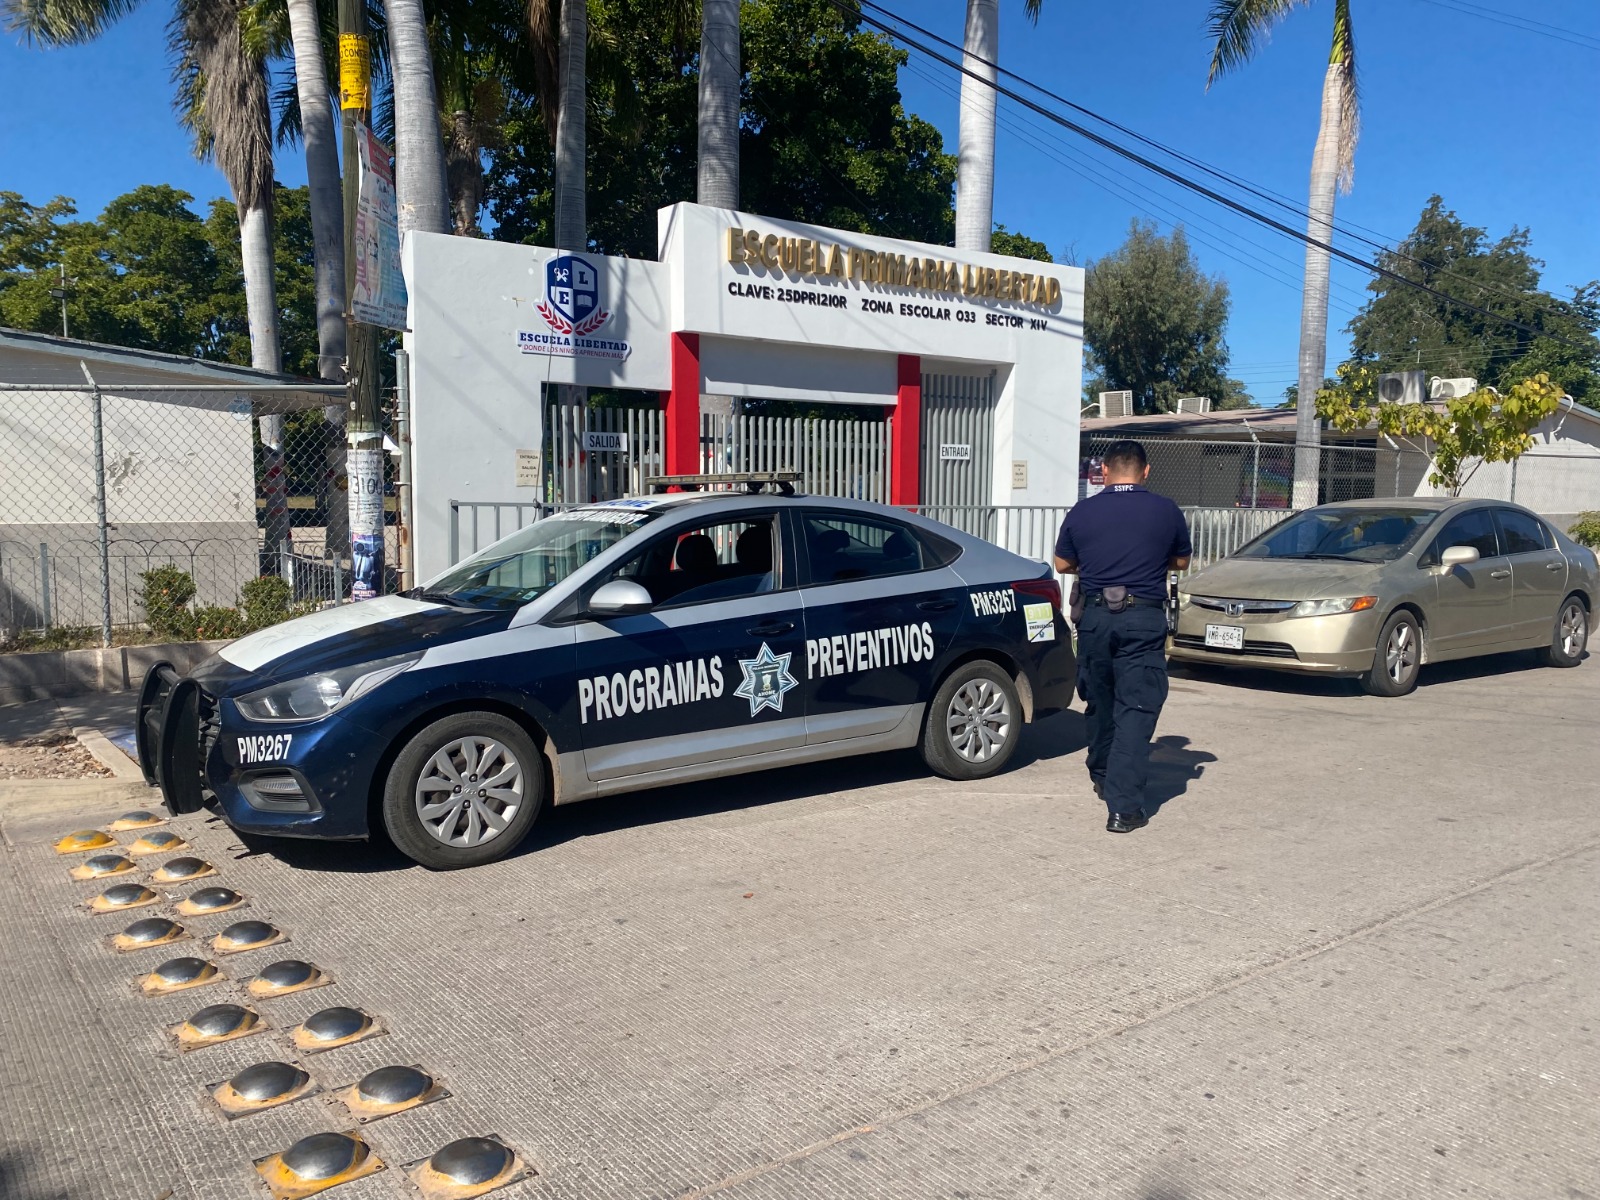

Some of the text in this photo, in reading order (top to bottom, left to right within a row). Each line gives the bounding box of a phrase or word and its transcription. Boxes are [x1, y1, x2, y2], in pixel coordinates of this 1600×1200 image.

[727, 226, 1062, 306] ESCUELA PRIMARIA LIBERTAD
[579, 271, 588, 285] L
[559, 291, 569, 305] E
[728, 282, 775, 300] CLAVE:
[861, 298, 894, 315] ZONA
[899, 303, 951, 321] ESCOLAR
[985, 313, 1024, 329] SECTOR
[1030, 318, 1048, 331] XIV
[520, 332, 628, 351] ESCUELA LIBERTAD
[523, 344, 546, 352] DONDE
[579, 349, 611, 359] APRENDEN
[589, 434, 621, 449] SALIDA
[941, 446, 969, 457] ENTRADA
[969, 588, 1017, 617] PM3267
[1027, 608, 1051, 619] 911
[578, 621, 935, 724] PROGRAMAS PREVENTIVOS
[237, 733, 293, 764] PM3267
